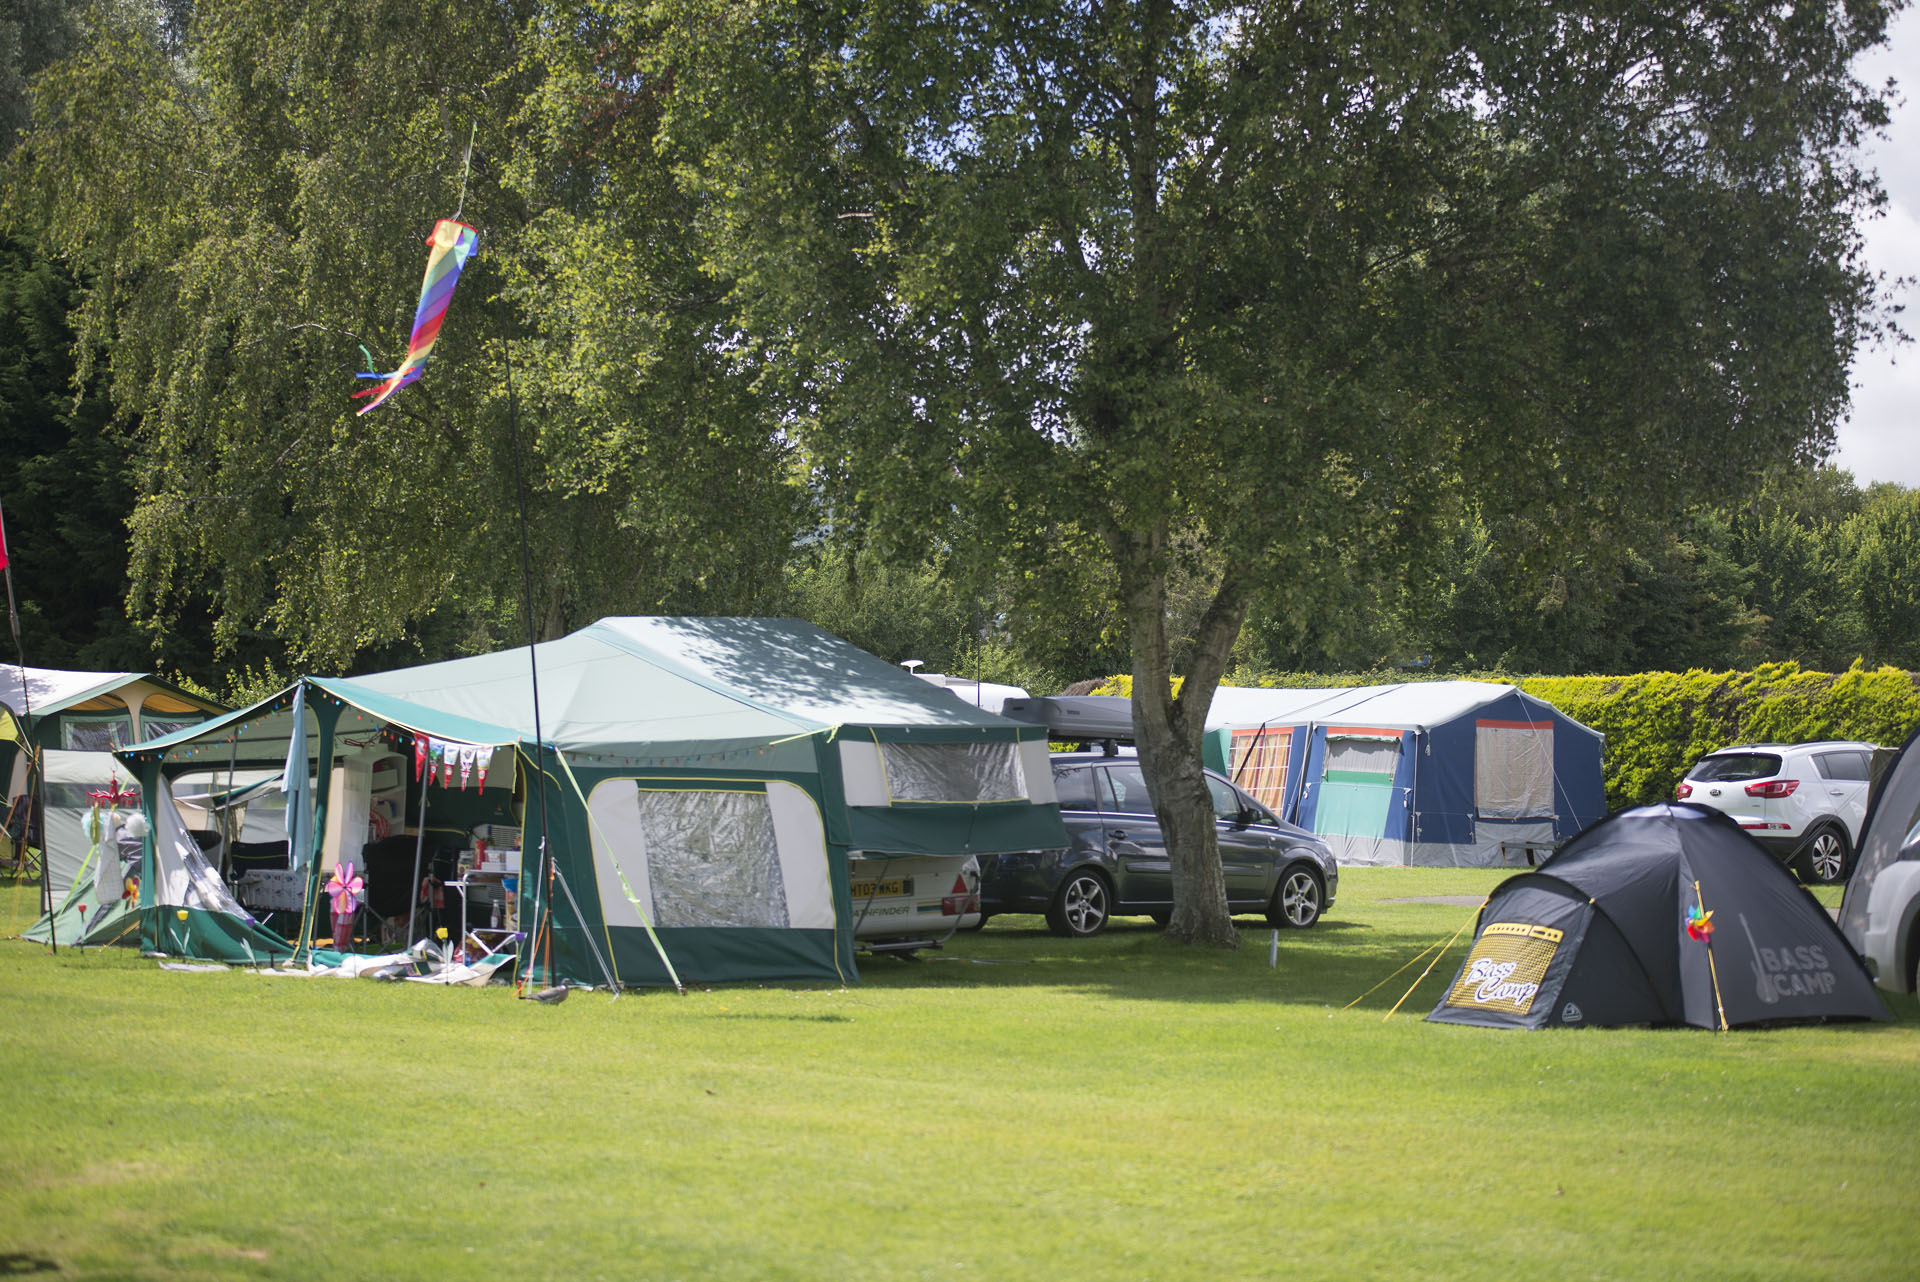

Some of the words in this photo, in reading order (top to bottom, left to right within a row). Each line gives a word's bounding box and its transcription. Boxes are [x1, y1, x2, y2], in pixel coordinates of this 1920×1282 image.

[853, 907, 909, 916] ATHFINDER
[1465, 958, 1516, 985] Bass
[1760, 944, 1829, 972] BASS
[1474, 977, 1539, 1006] Camp
[1773, 971, 1837, 996] CAMP
